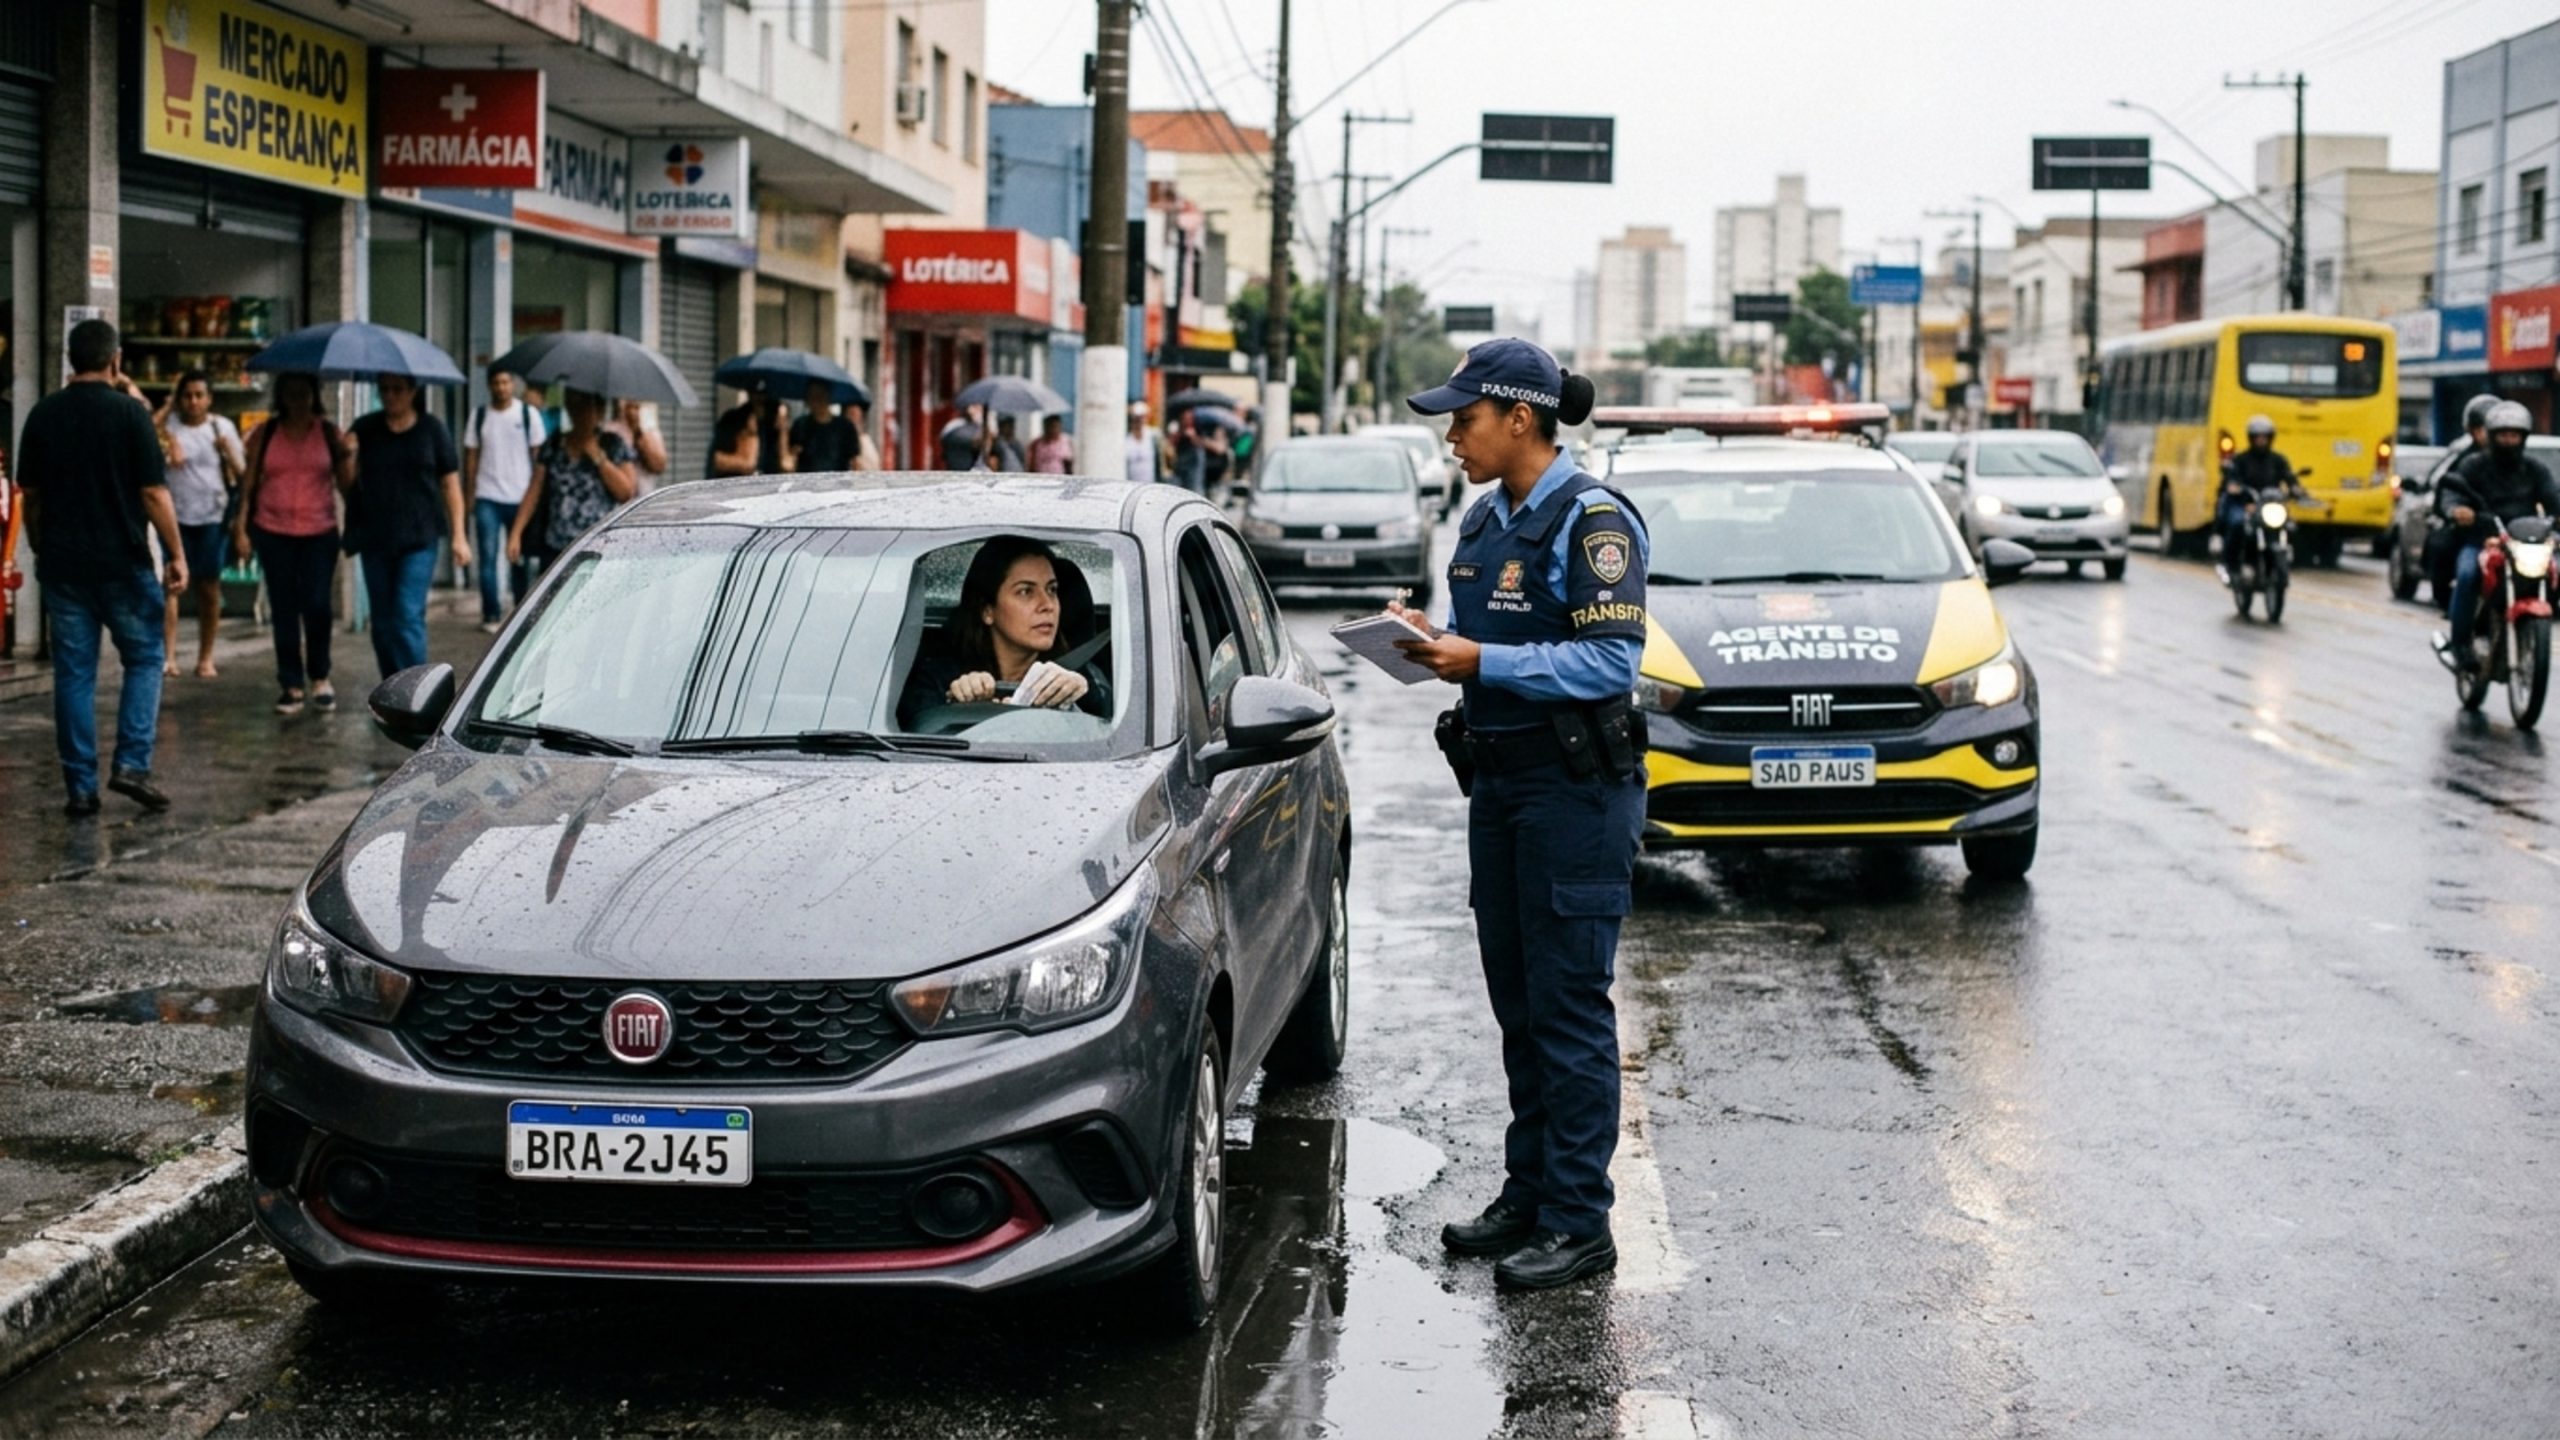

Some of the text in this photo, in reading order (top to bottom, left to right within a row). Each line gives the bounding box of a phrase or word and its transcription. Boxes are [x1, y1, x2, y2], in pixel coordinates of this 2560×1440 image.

[219, 11, 348, 105] MERCADO
[204, 84, 360, 185] ESPERANÇA
[382, 127, 535, 168] FARMÁCIA
[902, 252, 1010, 285] LOTÉRICA
[1708, 624, 1901, 646] AGENTE DE
[1791, 693, 1834, 726] FIAT
[617, 1013, 660, 1048] FIAT
